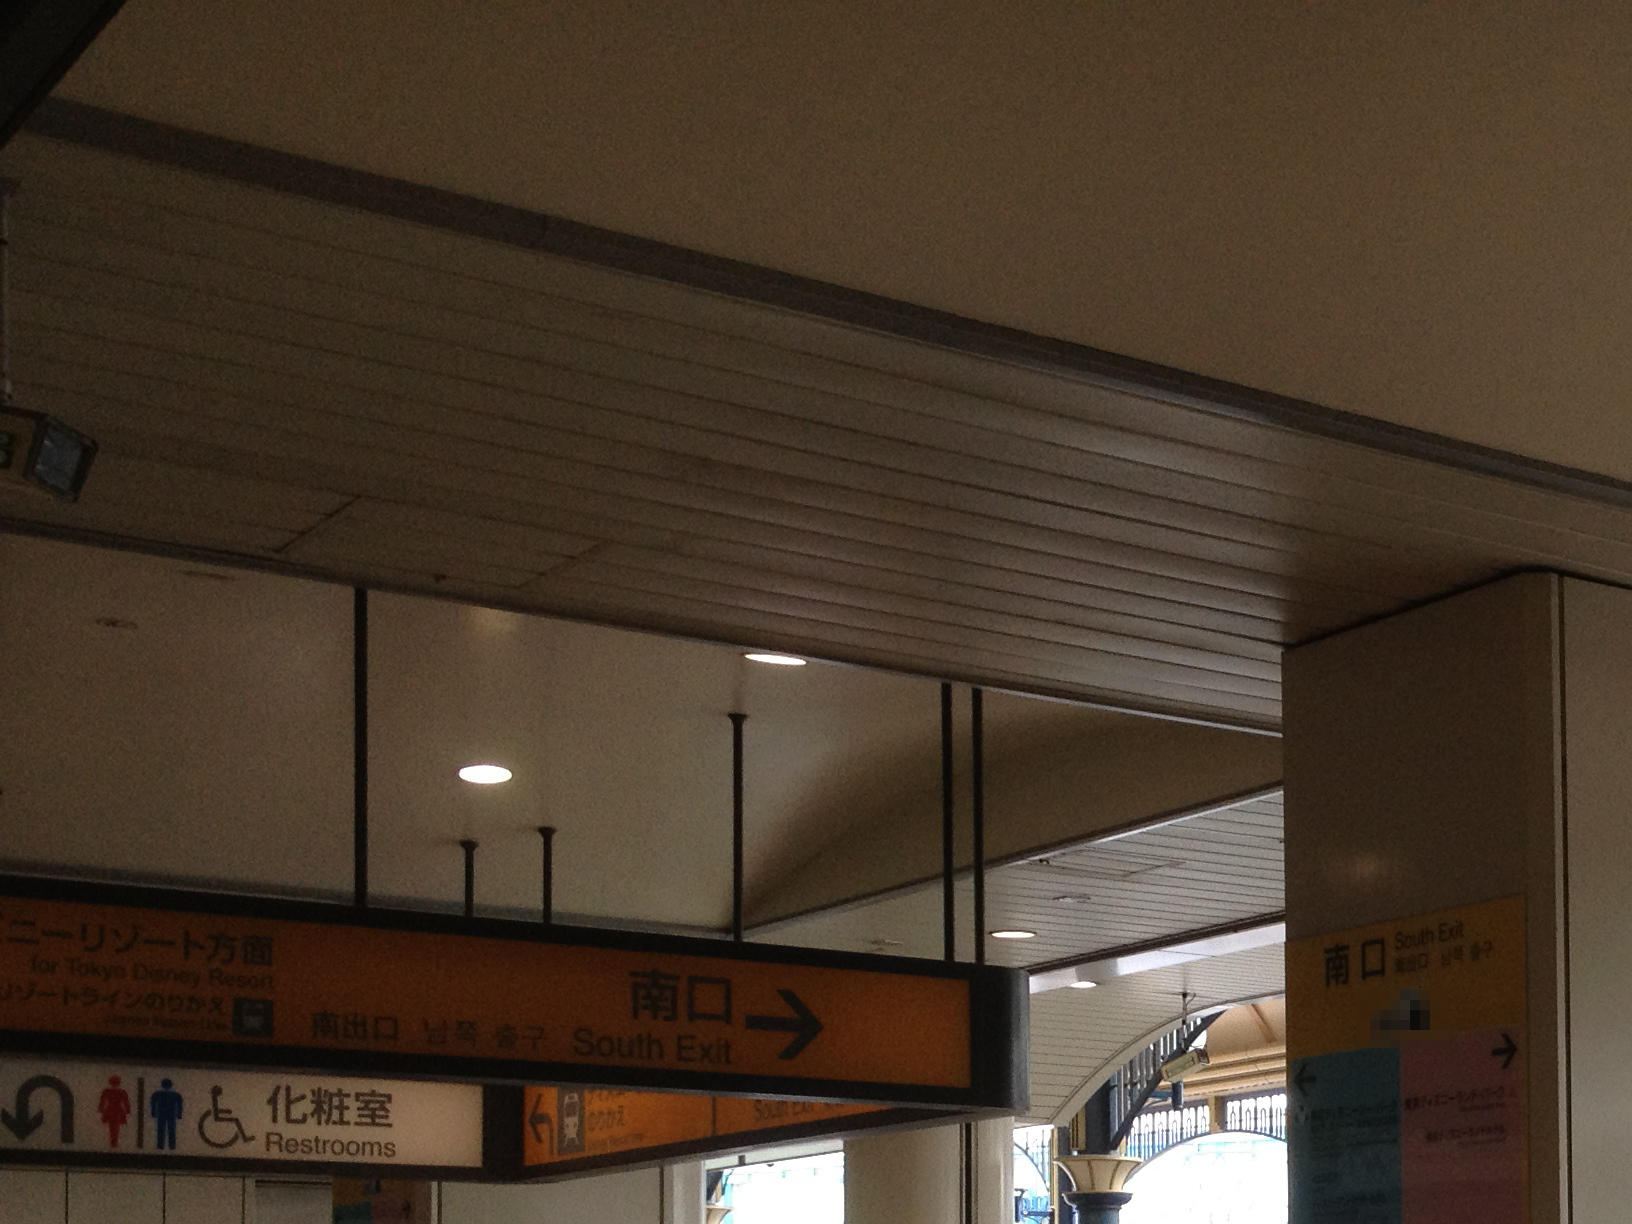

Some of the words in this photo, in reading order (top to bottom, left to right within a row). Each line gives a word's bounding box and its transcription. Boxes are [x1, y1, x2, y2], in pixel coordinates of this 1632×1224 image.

[1394, 926, 1434, 951] South
[1438, 919, 1464, 942] Exit
[31, 956, 59, 975] for
[67, 957, 127, 982] Tokyo
[132, 962, 200, 989] Disney
[208, 966, 273, 990] Resort
[1323, 937, 1386, 988] 南口
[629, 968, 732, 1026] 南口
[311, 1010, 399, 1042] 南出口
[573, 1028, 664, 1063] South
[676, 1034, 732, 1066] Exit
[266, 1084, 394, 1128] 化粧室
[265, 1132, 397, 1159] Restrooms
